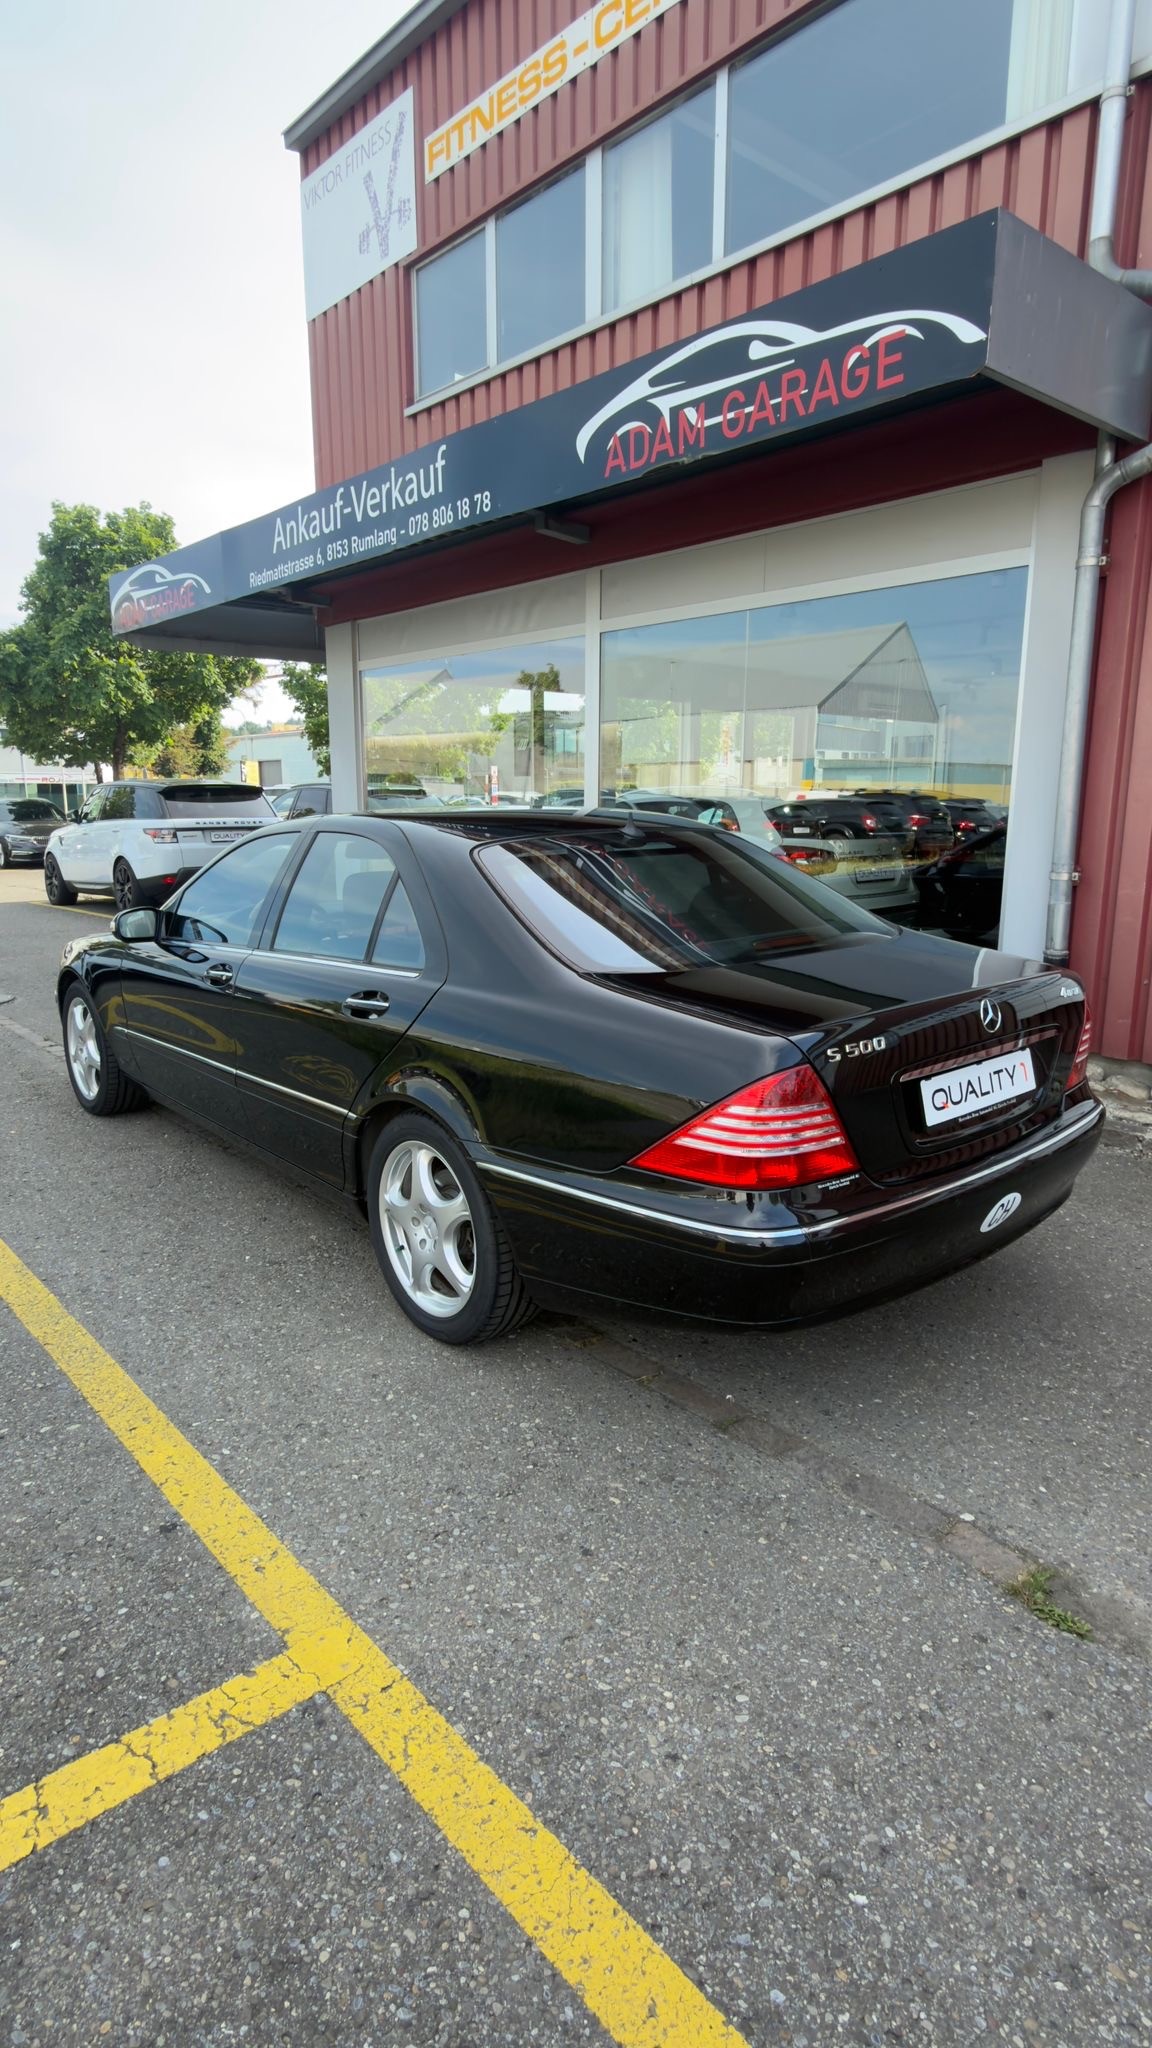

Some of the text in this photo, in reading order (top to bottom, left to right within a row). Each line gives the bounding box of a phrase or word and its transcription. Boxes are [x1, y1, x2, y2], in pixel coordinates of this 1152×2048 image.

[427, 0, 661, 174] FITNESS-CE
[303, 120, 392, 210] VIKTOR FITNESS
[604, 328, 907, 479] ADAM GARAGE
[249, 554, 314, 588] Riedmattstrasse
[316, 547, 325, 566] 6,
[326, 539, 349, 561] 8153
[351, 527, 397, 554] Rumlang
[408, 512, 429, 536] 078
[432, 503, 454, 529] 806
[456, 497, 470, 520] 18
[474, 490, 491, 514] 78
[272, 444, 447, 554] Ankauf-Verkauf
[826, 1036, 886, 1063] S 500
[987, 1197, 1017, 1228] CH
